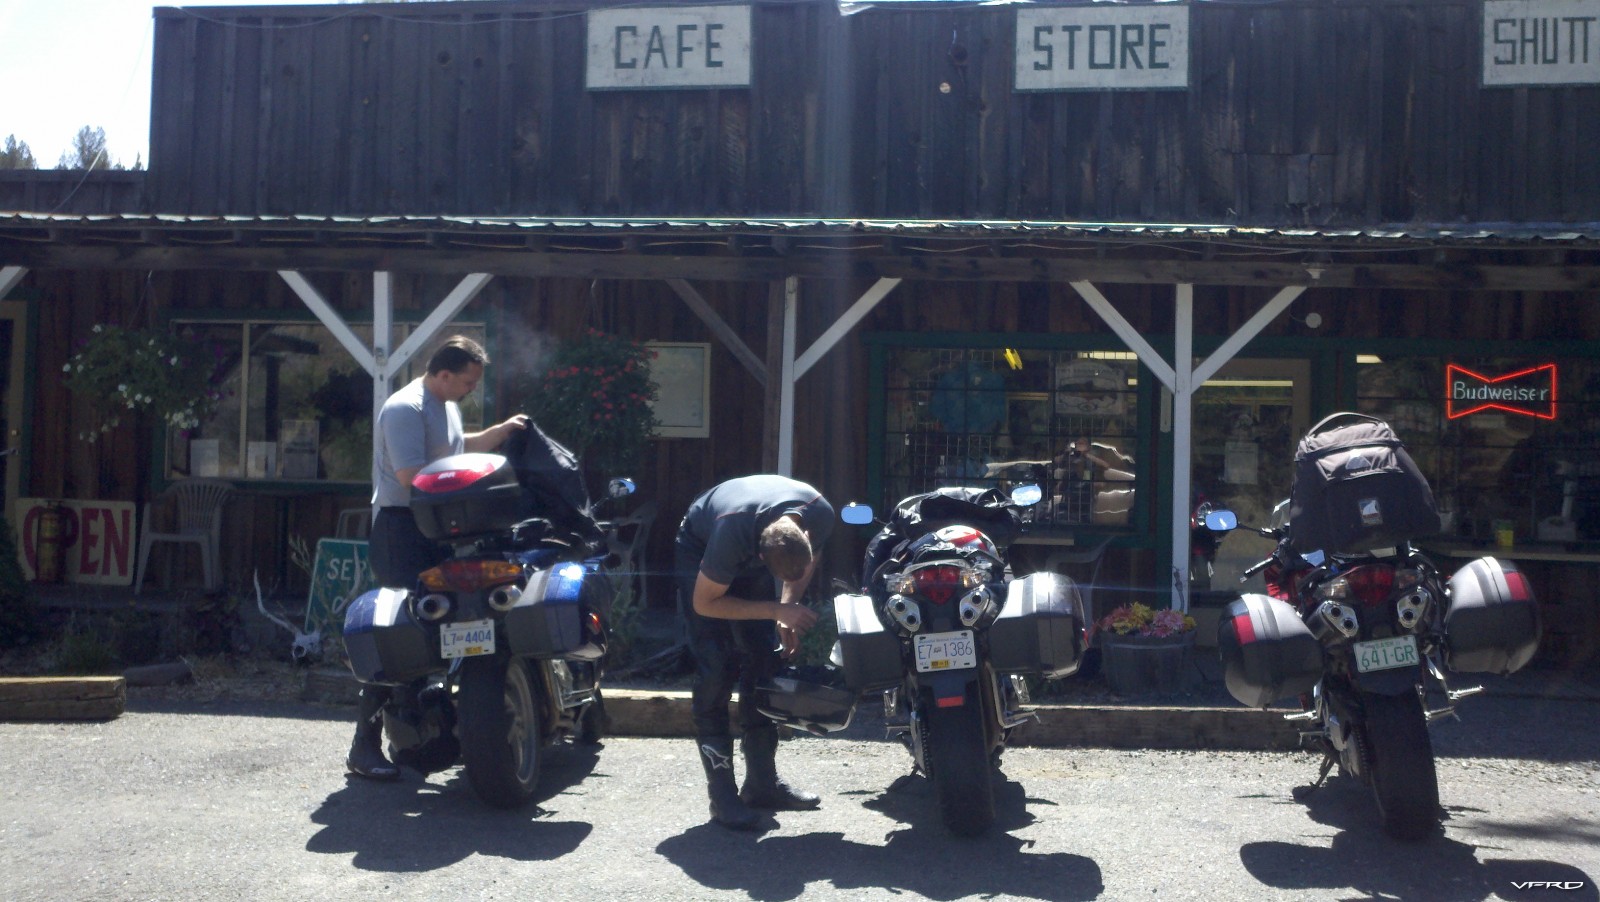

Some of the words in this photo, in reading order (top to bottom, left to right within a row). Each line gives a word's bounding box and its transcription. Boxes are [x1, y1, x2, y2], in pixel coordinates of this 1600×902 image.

[614, 25, 723, 69] CAFE
[1034, 24, 1171, 70] STORE
[1494, 17, 1597, 65] SHUTT
[1453, 381, 1549, 401] Budweiser
[943, 641, 973, 657] 1386
